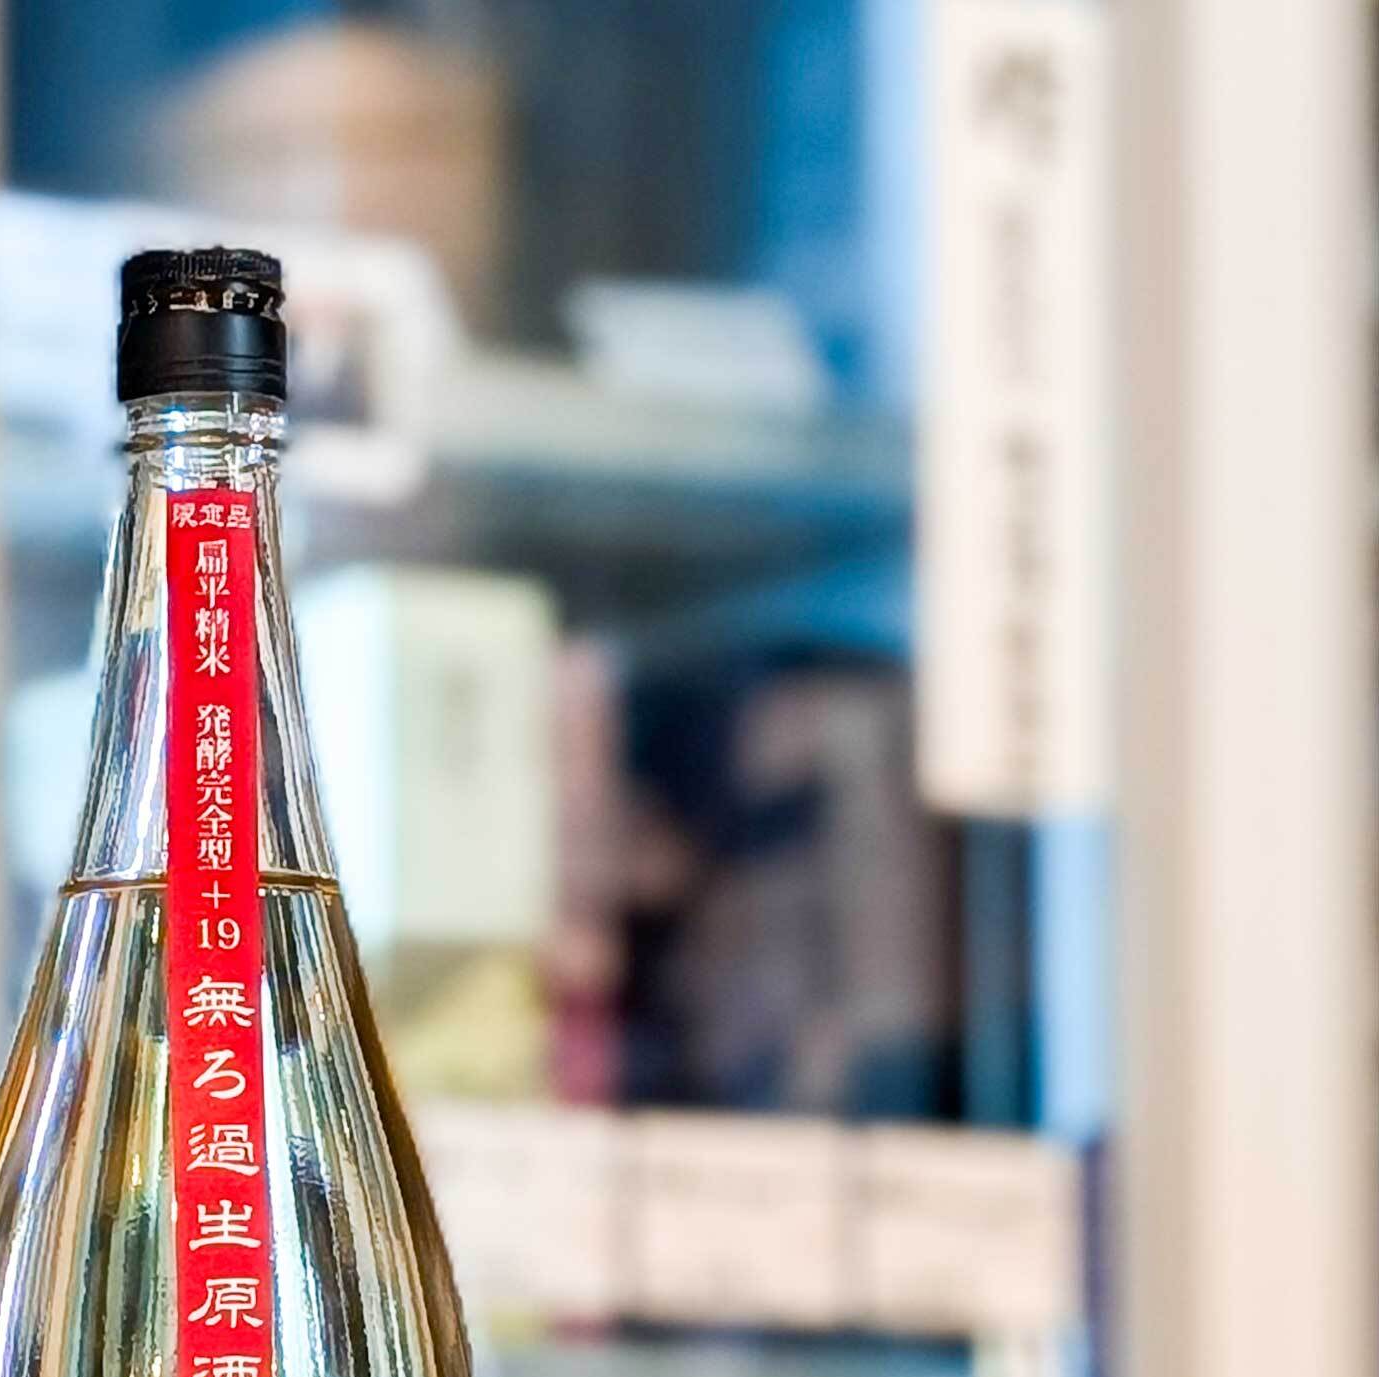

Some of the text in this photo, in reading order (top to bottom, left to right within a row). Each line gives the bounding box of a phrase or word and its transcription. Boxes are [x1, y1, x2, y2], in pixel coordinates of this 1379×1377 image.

[172, 503, 252, 529] 限定品
[195, 539, 231, 677] 扁平精米
